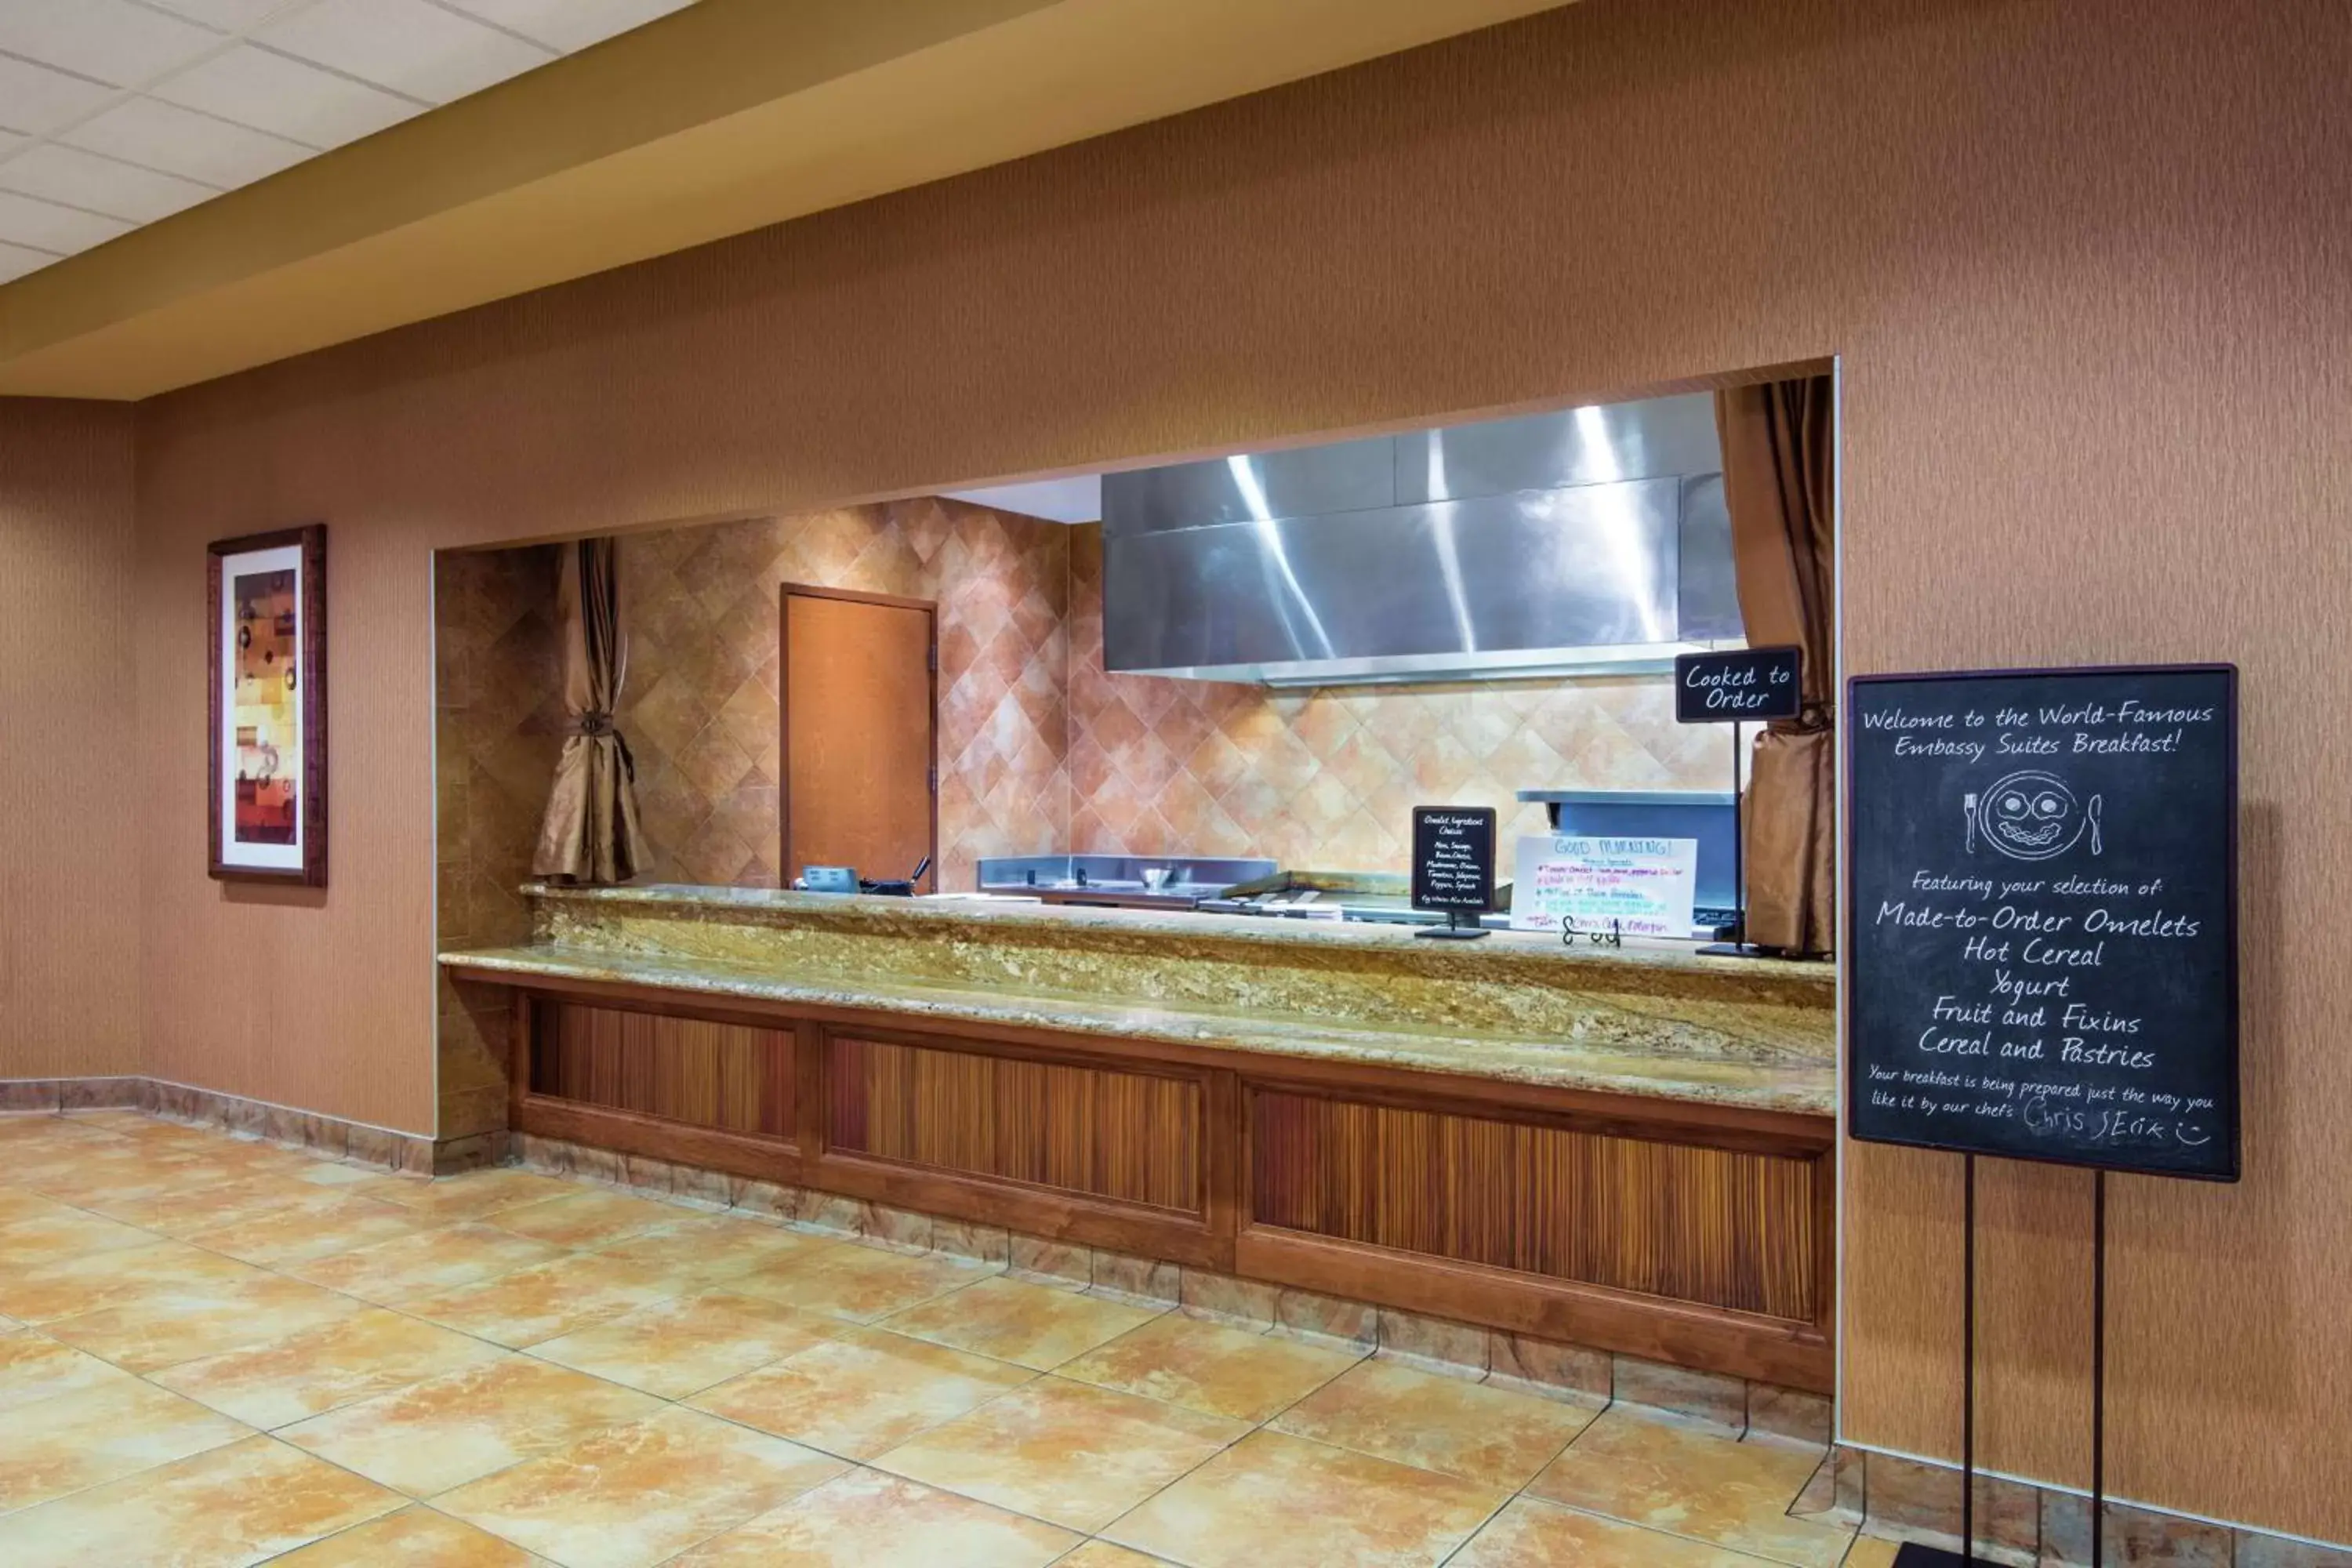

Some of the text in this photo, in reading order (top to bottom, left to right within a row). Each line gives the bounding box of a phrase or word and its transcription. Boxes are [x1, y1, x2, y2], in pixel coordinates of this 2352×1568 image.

[1686, 665, 1790, 688] Cooked to
[1706, 688, 1769, 708] Order
[1864, 699, 2215, 730] Welcome to the World-Famous
[1895, 728, 2183, 764] Embassy Suites Breakfast!
[1555, 839, 1592, 856] GOOD
[1912, 869, 1993, 901] Featuring
[1998, 880, 2045, 899] your
[2053, 874, 2129, 895] selection
[1876, 900, 2201, 937] Made-to-Order Omelets
[1964, 935, 2104, 966] Hot Cereal
[1990, 969, 2070, 1006] Yogurt
[1933, 995, 2143, 1034] Fruit and Fixins
[1918, 1025, 2156, 1069] Cereal and Pastries
[1868, 1063, 2215, 1113] Your breakfast is being prepared just the way you
[1871, 1091, 1896, 1106] like
[1900, 1096, 1915, 1109] it
[1921, 1097, 1938, 1116] by
[1942, 1102, 1971, 1114] our
[2023, 1095, 2085, 1131] Chris
